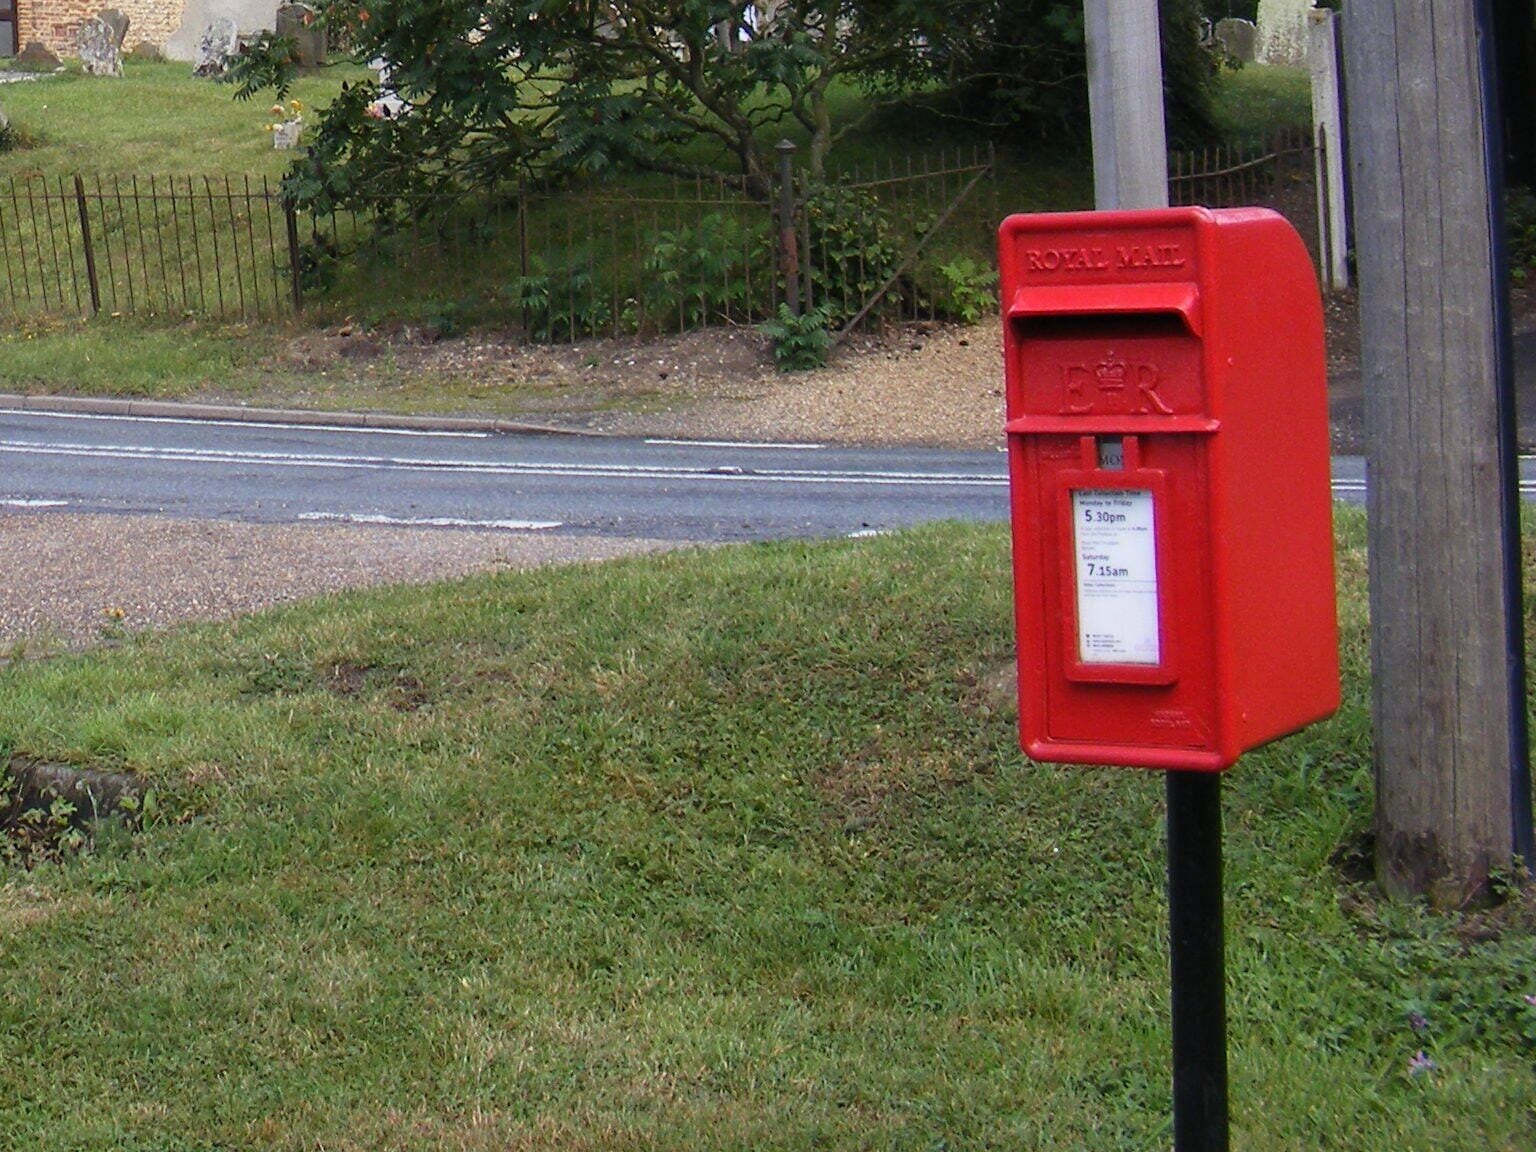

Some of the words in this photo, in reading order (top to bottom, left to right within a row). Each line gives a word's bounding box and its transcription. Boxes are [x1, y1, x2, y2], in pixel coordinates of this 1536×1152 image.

[1026, 248, 1110, 270] ROYAL
[1116, 244, 1186, 268] MAIL
[1098, 455, 1124, 466] MO
[1079, 499, 1103, 507] Monday
[1113, 499, 1133, 507] Friday
[1084, 509, 1126, 524] 5.30pm
[1082, 553, 1110, 561] Saturday
[1087, 563, 1129, 576] 7.15am
